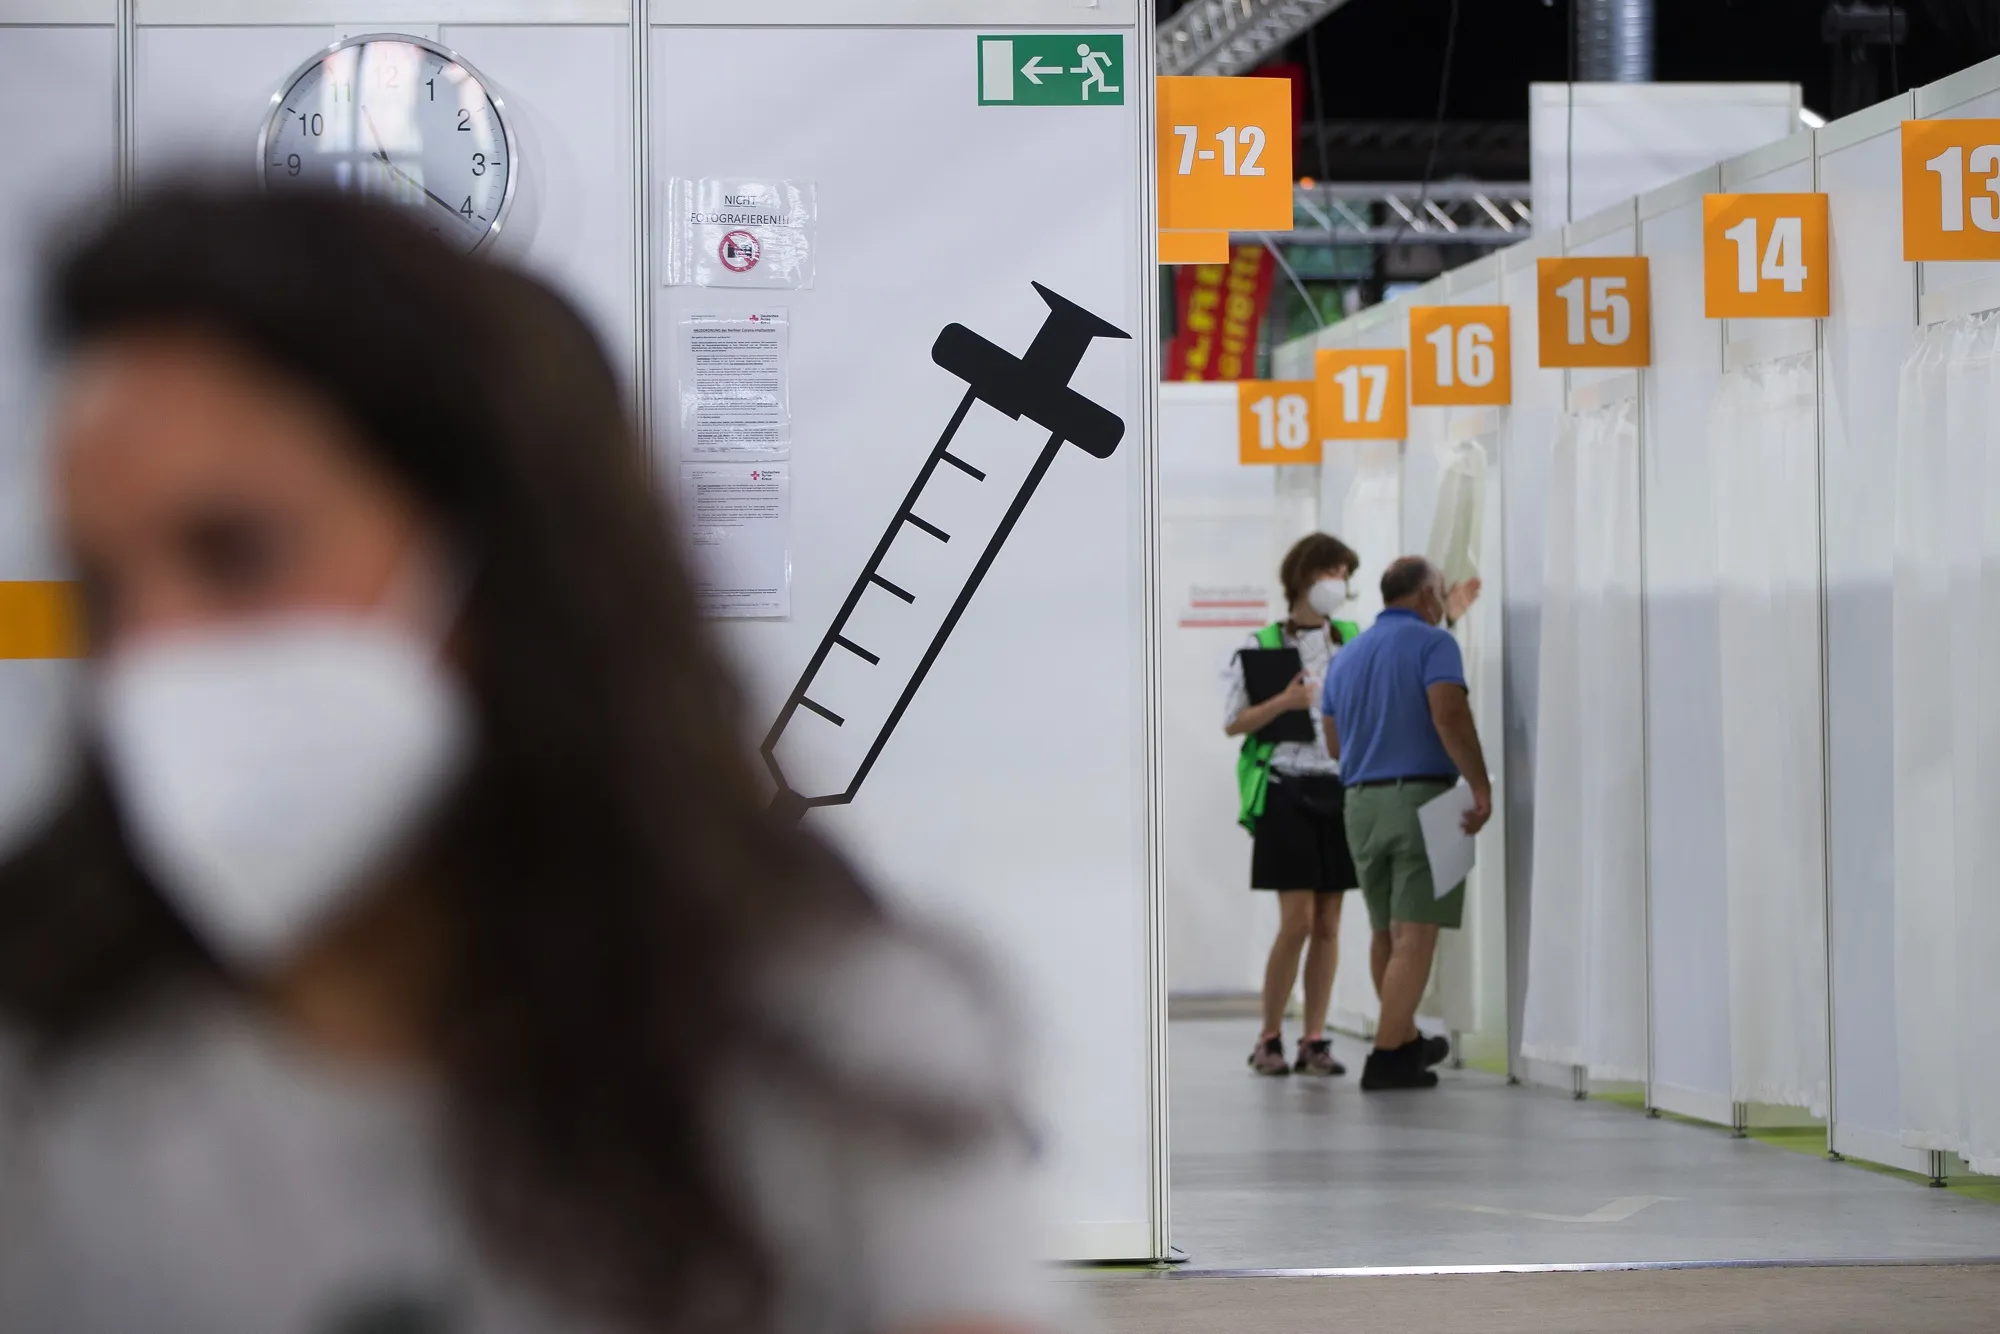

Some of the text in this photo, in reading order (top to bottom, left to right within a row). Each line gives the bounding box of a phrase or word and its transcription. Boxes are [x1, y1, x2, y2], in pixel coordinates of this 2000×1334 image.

[373, 65, 399, 89] 12
[425, 78, 435, 102] 1
[298, 113, 324, 137] 10
[457, 108, 471, 132] 2
[1173, 125, 1266, 177] 7-12
[287, 153, 302, 177] 9
[471, 153, 486, 176] 3
[723, 195, 756, 206] NICHT
[1926, 144, 2000, 233] 13
[460, 195, 474, 219] 4
[1724, 217, 1808, 293] 14
[1556, 277, 1630, 345] 15
[1425, 323, 1495, 387] 16
[1333, 364, 1389, 423] 17
[1250, 394, 1309, 449] 18
